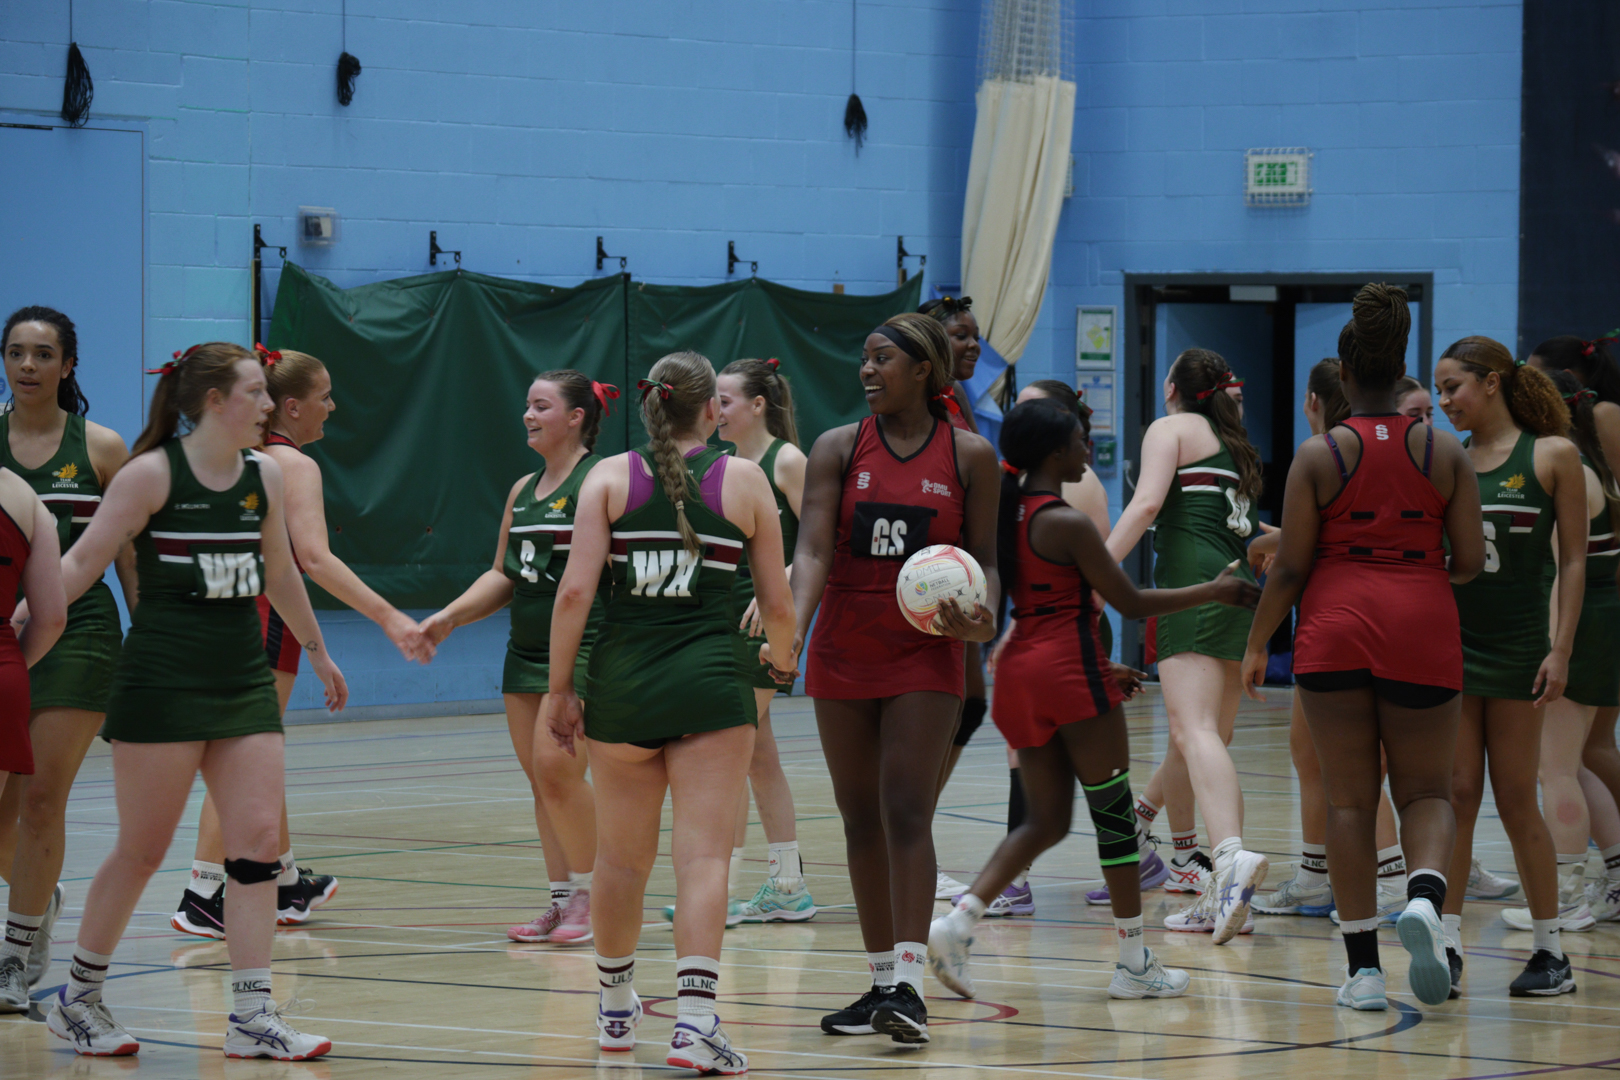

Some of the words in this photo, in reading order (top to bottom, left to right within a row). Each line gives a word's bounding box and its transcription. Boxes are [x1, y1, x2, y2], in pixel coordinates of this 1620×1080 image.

[932, 488, 952, 497] SPORT
[933, 482, 948, 490] DMU
[870, 517, 907, 556] GS
[631, 549, 700, 597] WA
[682, 977, 717, 991] ULNC
